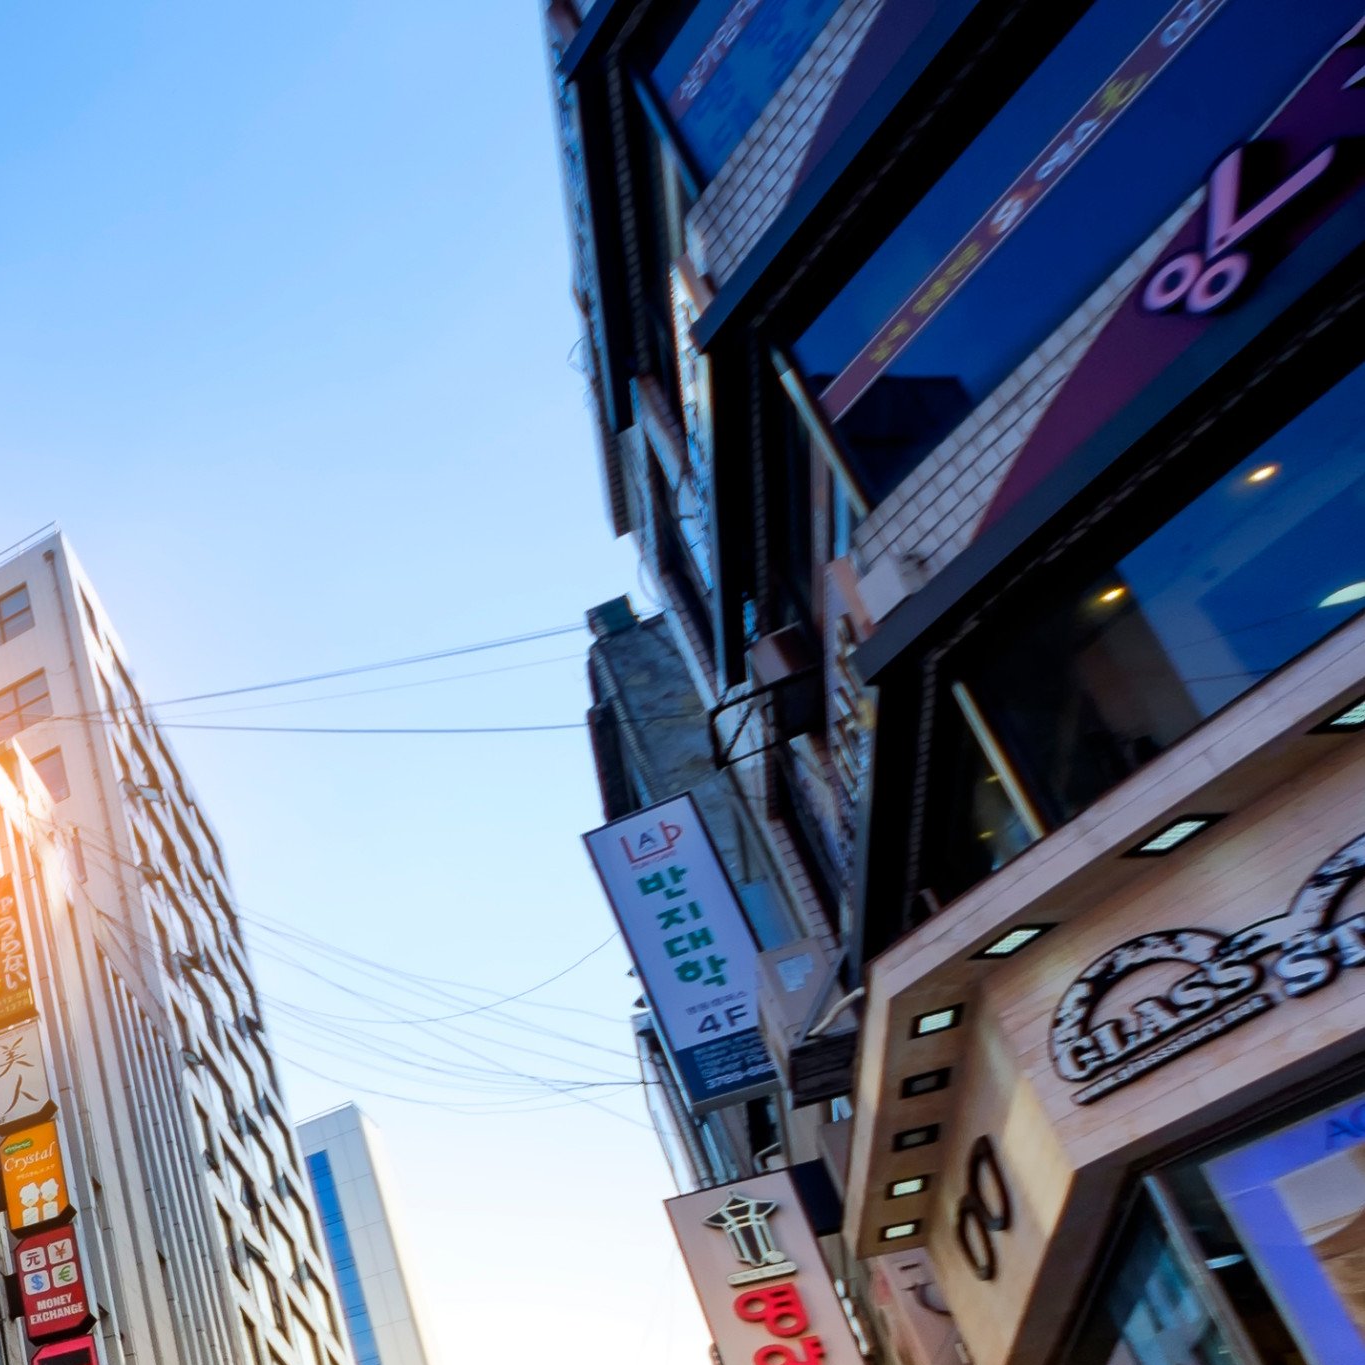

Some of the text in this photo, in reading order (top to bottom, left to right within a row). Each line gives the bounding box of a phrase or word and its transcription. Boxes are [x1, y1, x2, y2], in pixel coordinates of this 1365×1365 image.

[636, 865, 727, 987] 반지대학
[697, 1004, 749, 1034] 4F
[1057, 955, 1267, 1080] GLASS
[3, 1141, 57, 1173] Crystal
[25, 1251, 42, 1267] 元
[29, 1266, 74, 1291] $ €
[29, 1301, 85, 1326] EXCHANGE
[36, 1292, 73, 1312] MONEY
